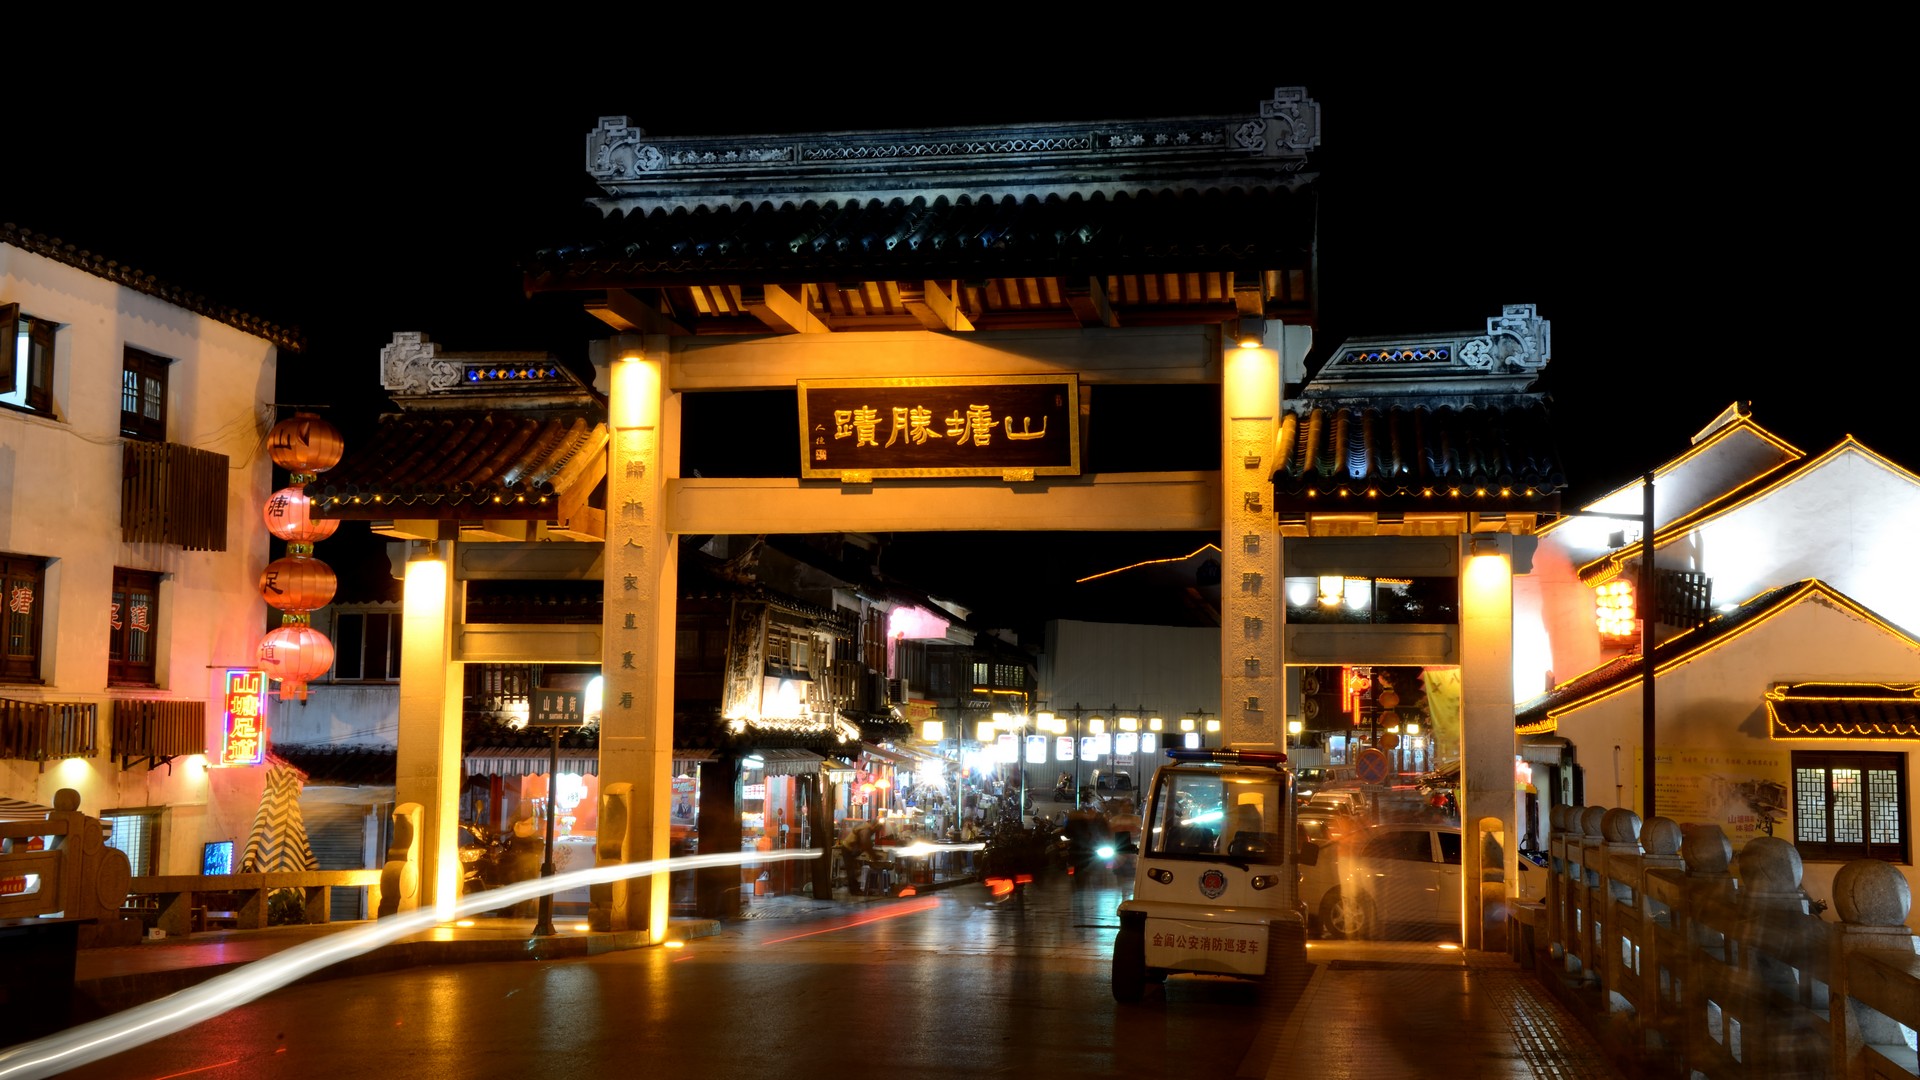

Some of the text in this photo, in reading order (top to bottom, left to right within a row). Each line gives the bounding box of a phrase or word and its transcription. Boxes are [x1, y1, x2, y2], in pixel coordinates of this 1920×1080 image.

[0, 586, 34, 615] 塘
[228, 674, 259, 760] 山塘足道
[543, 695, 577, 713] 山塘街
[1152, 932, 1260, 955] 金阊公安消防巡逻车
